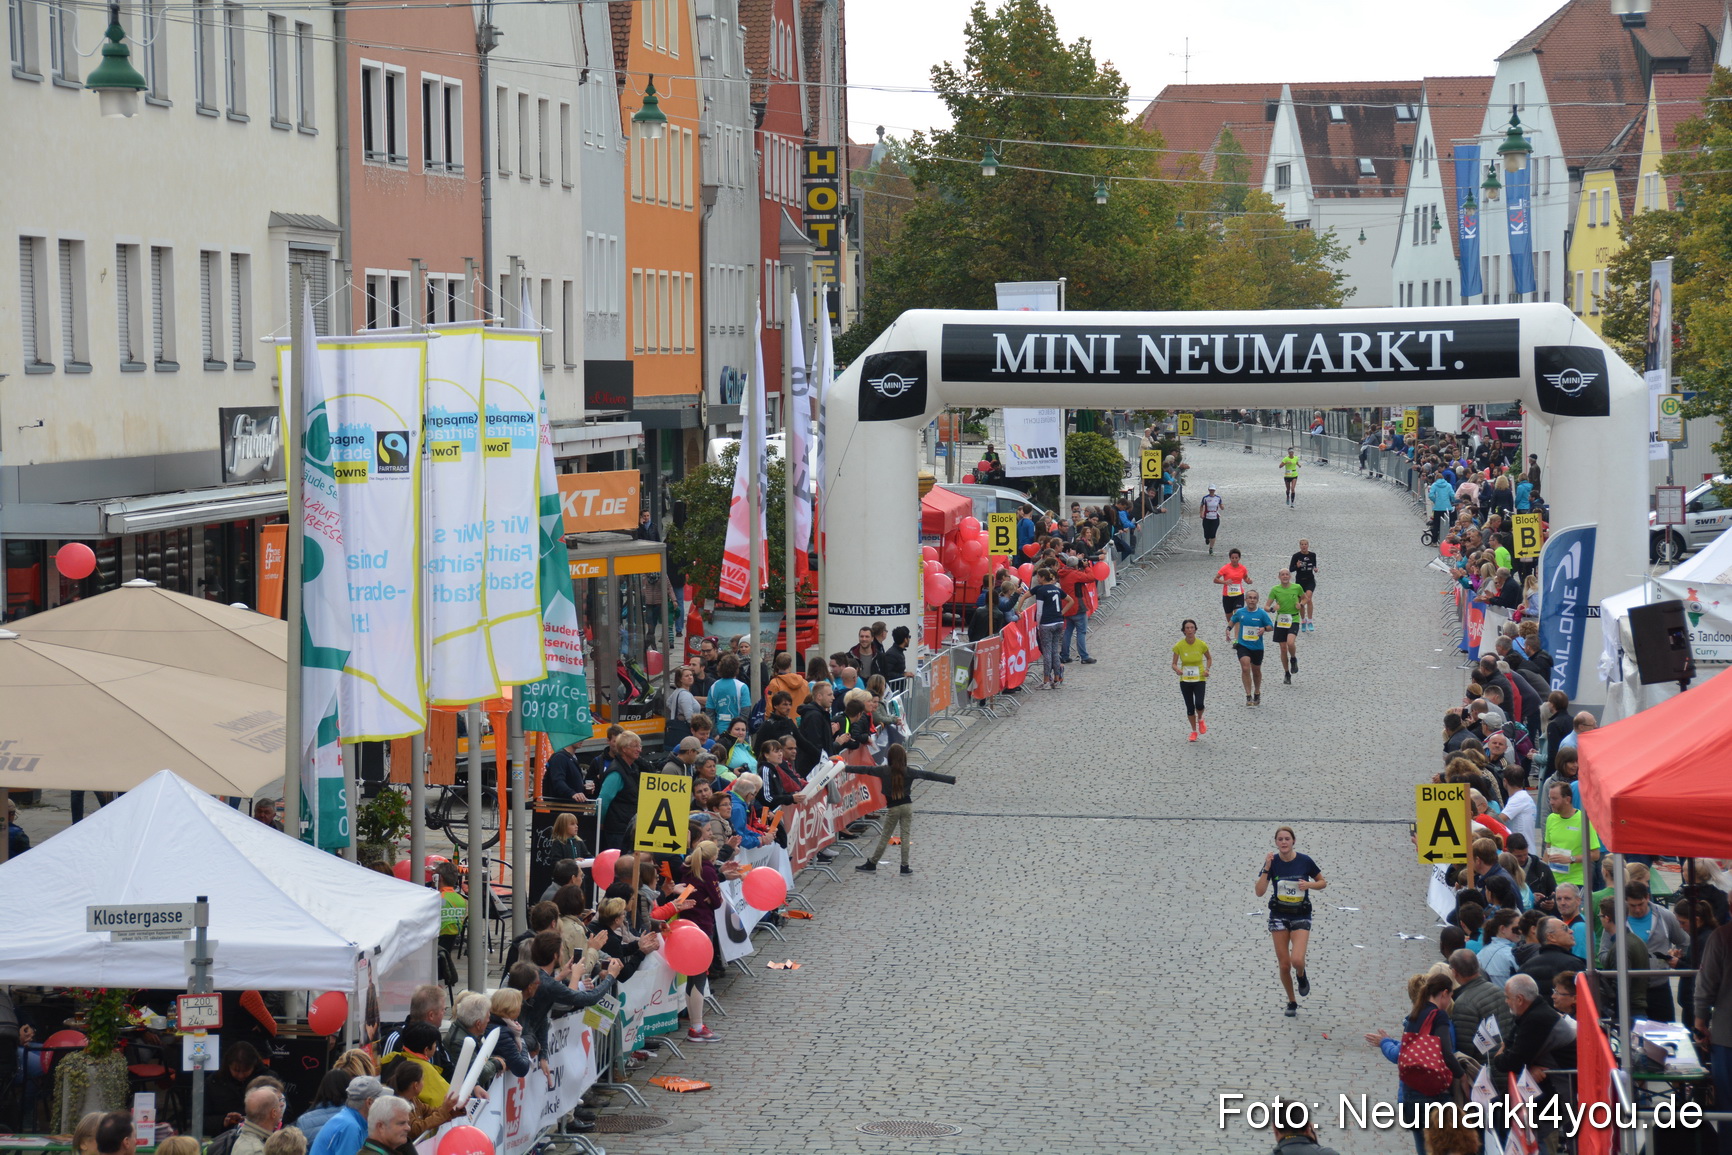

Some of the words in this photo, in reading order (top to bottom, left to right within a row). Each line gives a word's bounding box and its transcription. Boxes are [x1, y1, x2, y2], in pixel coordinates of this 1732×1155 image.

[1509, 198, 1525, 235] K&L
[808, 150, 838, 319] HOTEL
[991, 332, 1121, 375] MINI
[1136, 330, 1465, 375] NEUMARKT.
[883, 381, 902, 389] MINI
[1561, 376, 1581, 385] MINI
[1181, 420, 1190, 431] D
[1406, 416, 1415, 428] D
[328, 435, 365, 447] pagne
[331, 446, 372, 460] trade
[1146, 458, 1157, 473] C
[560, 488, 628, 518] KT.DE
[991, 514, 1014, 523] Block
[1515, 514, 1539, 525] Block
[1694, 517, 1717, 526] swn
[995, 526, 1010, 546] B
[1520, 527, 1537, 548] B
[347, 549, 388, 570] sind
[347, 580, 406, 602] trade-
[828, 604, 908, 615] www.MINI-Partl.de
[1052, 593, 1061, 613] 1
[1551, 584, 1578, 692] RAIL.ONE
[1695, 647, 1718, 657] Curry
[521, 700, 569, 720] 09181
[646, 776, 687, 794] Block
[1422, 786, 1465, 802] Block
[647, 798, 677, 837] A
[1429, 807, 1461, 847] A
[94, 909, 183, 928] Klostergasse
[183, 999, 189, 1007] H
[194, 998, 211, 1006] 200
